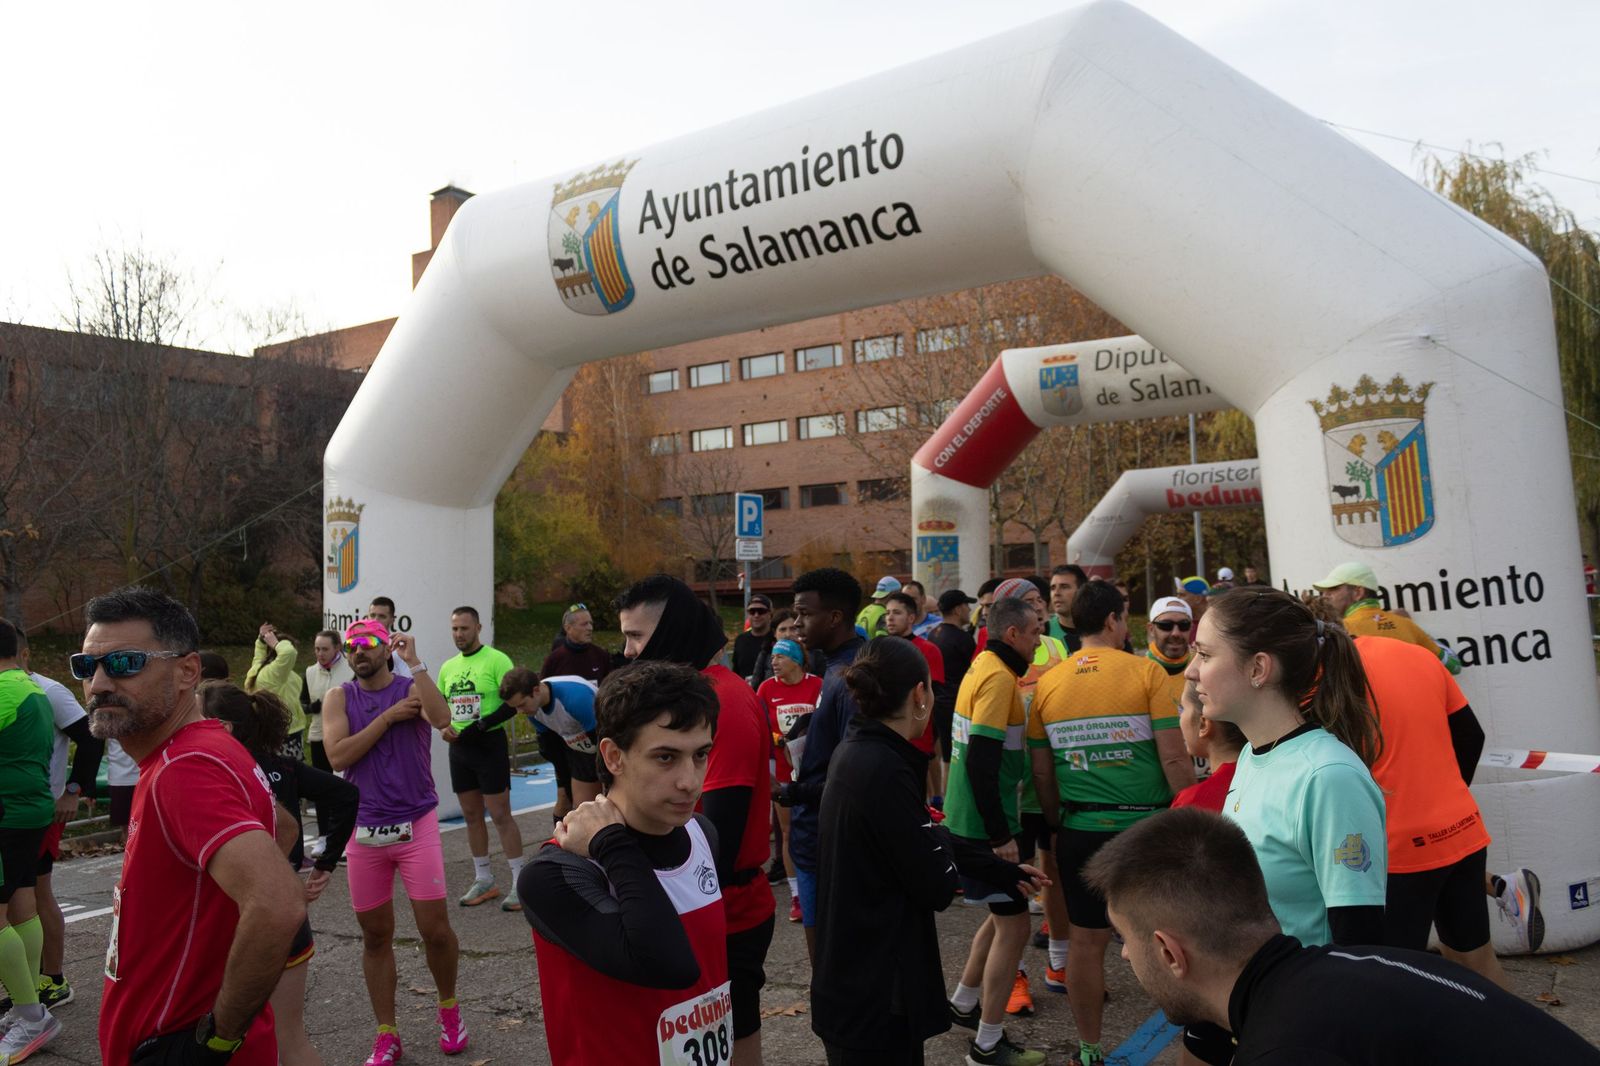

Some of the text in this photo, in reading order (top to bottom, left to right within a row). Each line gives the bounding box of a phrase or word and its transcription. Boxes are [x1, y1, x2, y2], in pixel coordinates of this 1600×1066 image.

[638, 129, 904, 240] Ayuntamiento
[650, 200, 922, 291] de Salamanca
[1096, 386, 1121, 406] de
[934, 387, 1008, 468] CON EL DEPORTE
[743, 500, 758, 532] P
[455, 704, 473, 715] 233
[1069, 732, 1109, 743] REGALAR
[1089, 749, 1134, 761] ALCER
[1427, 828, 1448, 840] TALLER
[684, 1023, 729, 1066] 308
